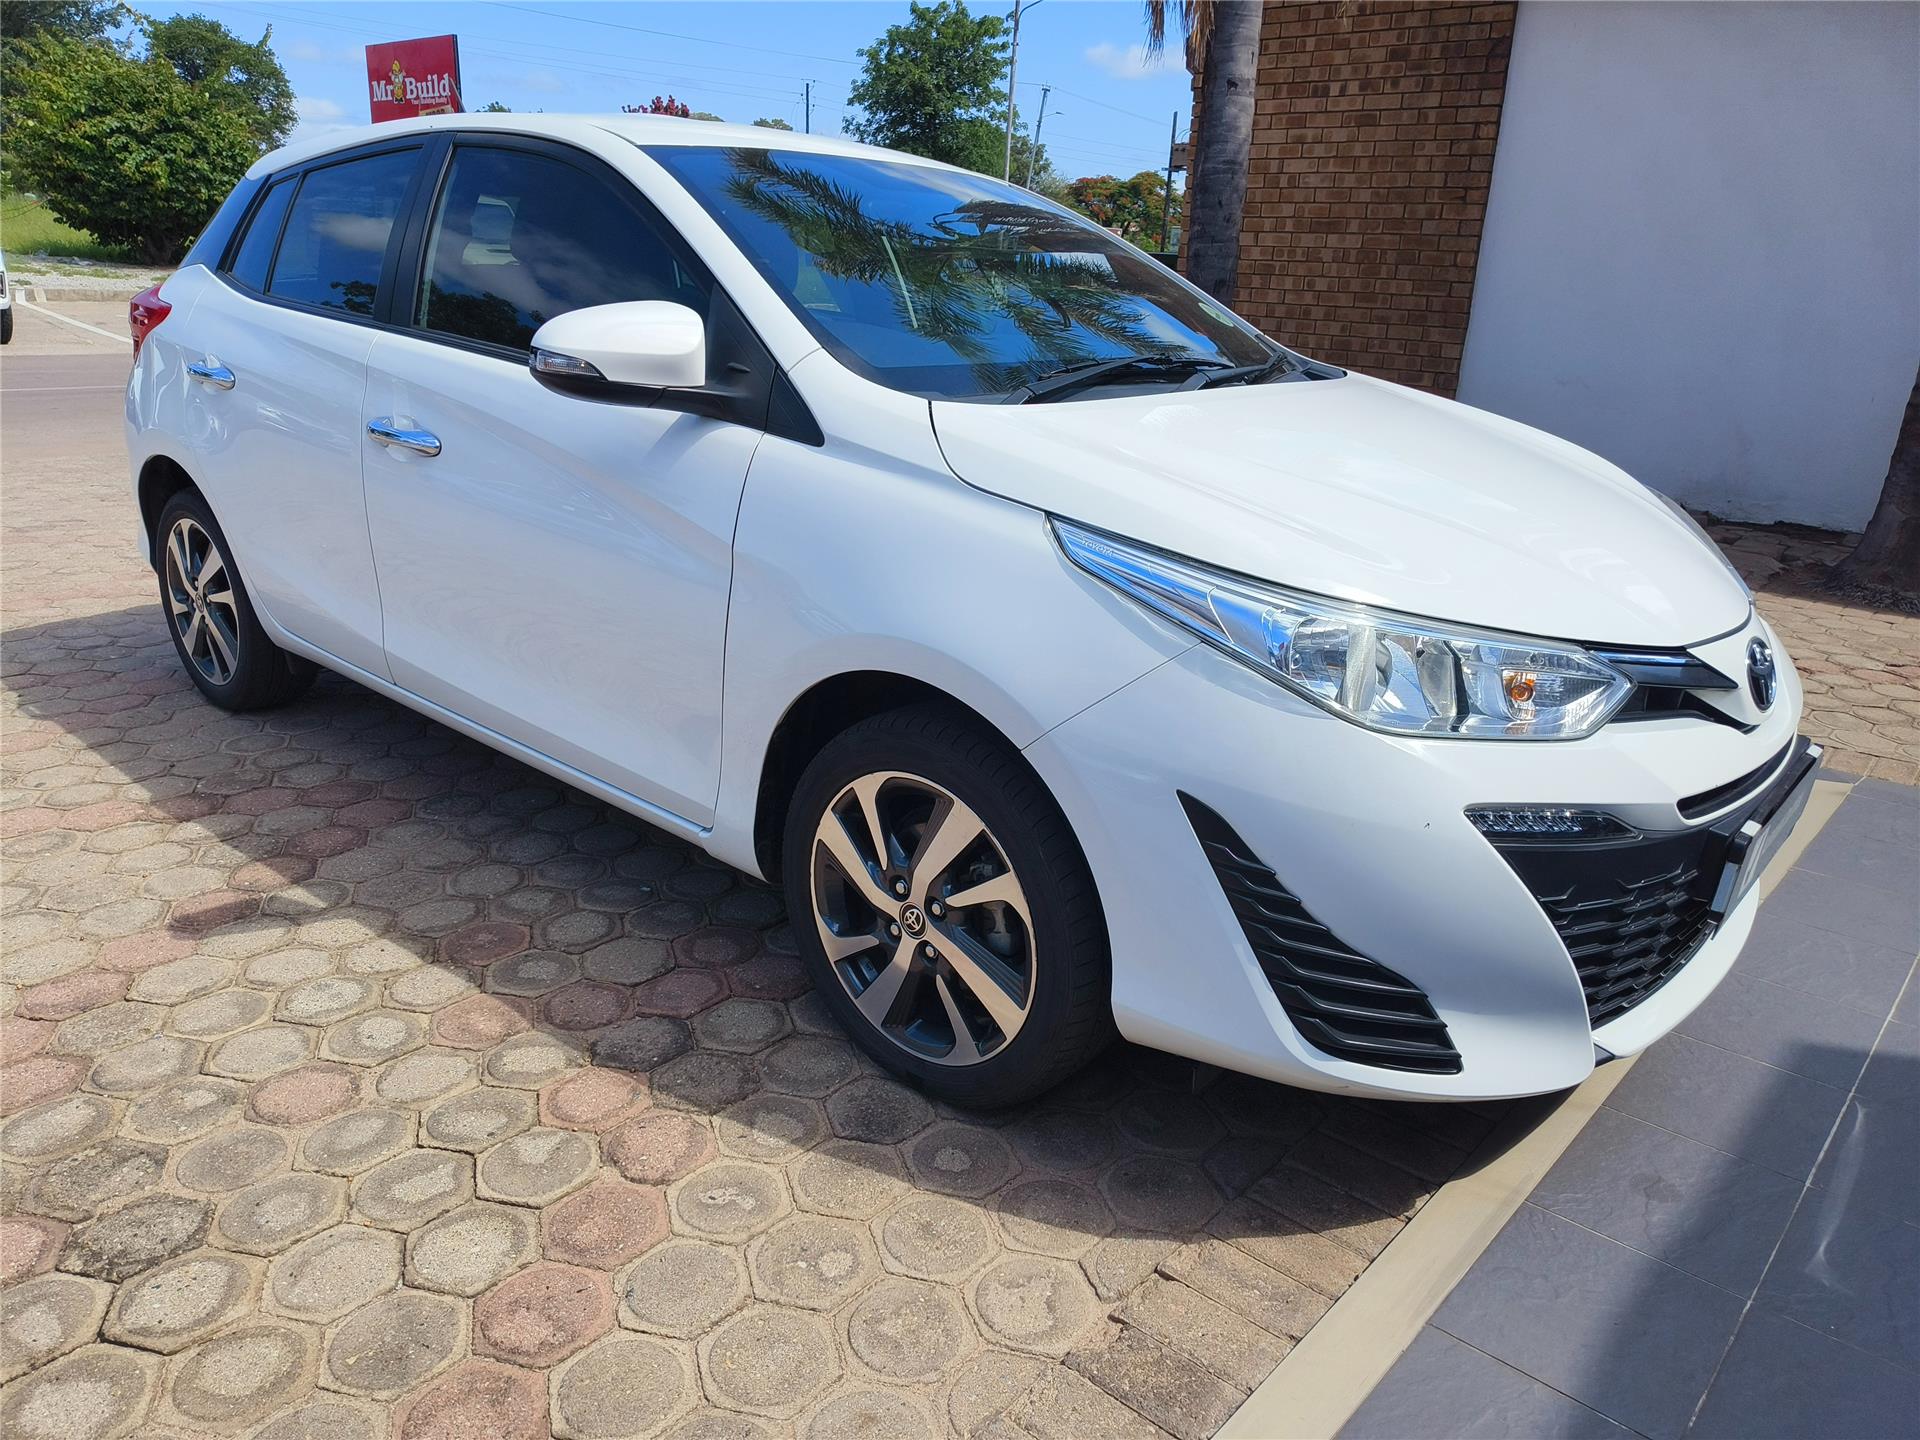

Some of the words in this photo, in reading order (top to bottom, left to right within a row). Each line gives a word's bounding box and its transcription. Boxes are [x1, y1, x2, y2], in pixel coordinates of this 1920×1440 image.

[372, 80, 394, 102] Mr
[405, 73, 451, 98] Build
[1082, 537, 1113, 556] TOYOTA
